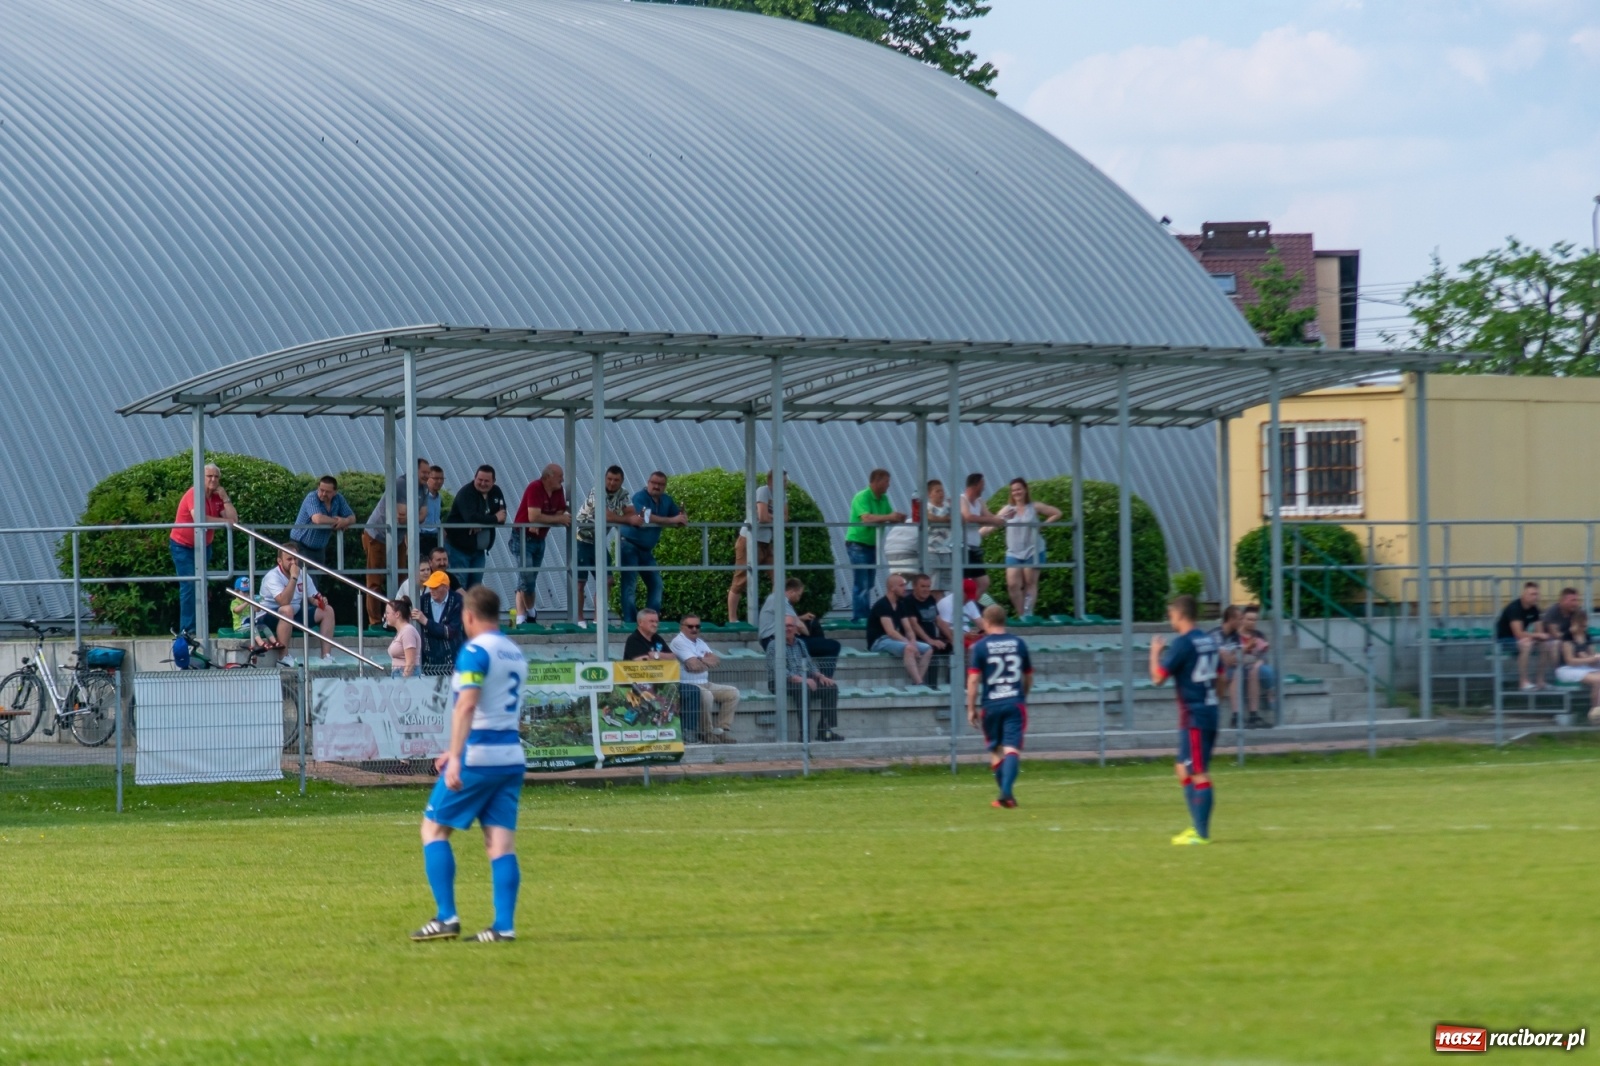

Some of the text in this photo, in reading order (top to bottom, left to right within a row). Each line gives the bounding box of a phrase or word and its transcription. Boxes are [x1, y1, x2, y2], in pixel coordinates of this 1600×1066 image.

[591, 670, 597, 679] &
[599, 670, 604, 679] L
[987, 655, 1021, 685] 23
[344, 684, 412, 714] SAXO
[504, 671, 520, 712] 3
[404, 714, 444, 726] KANTOR
